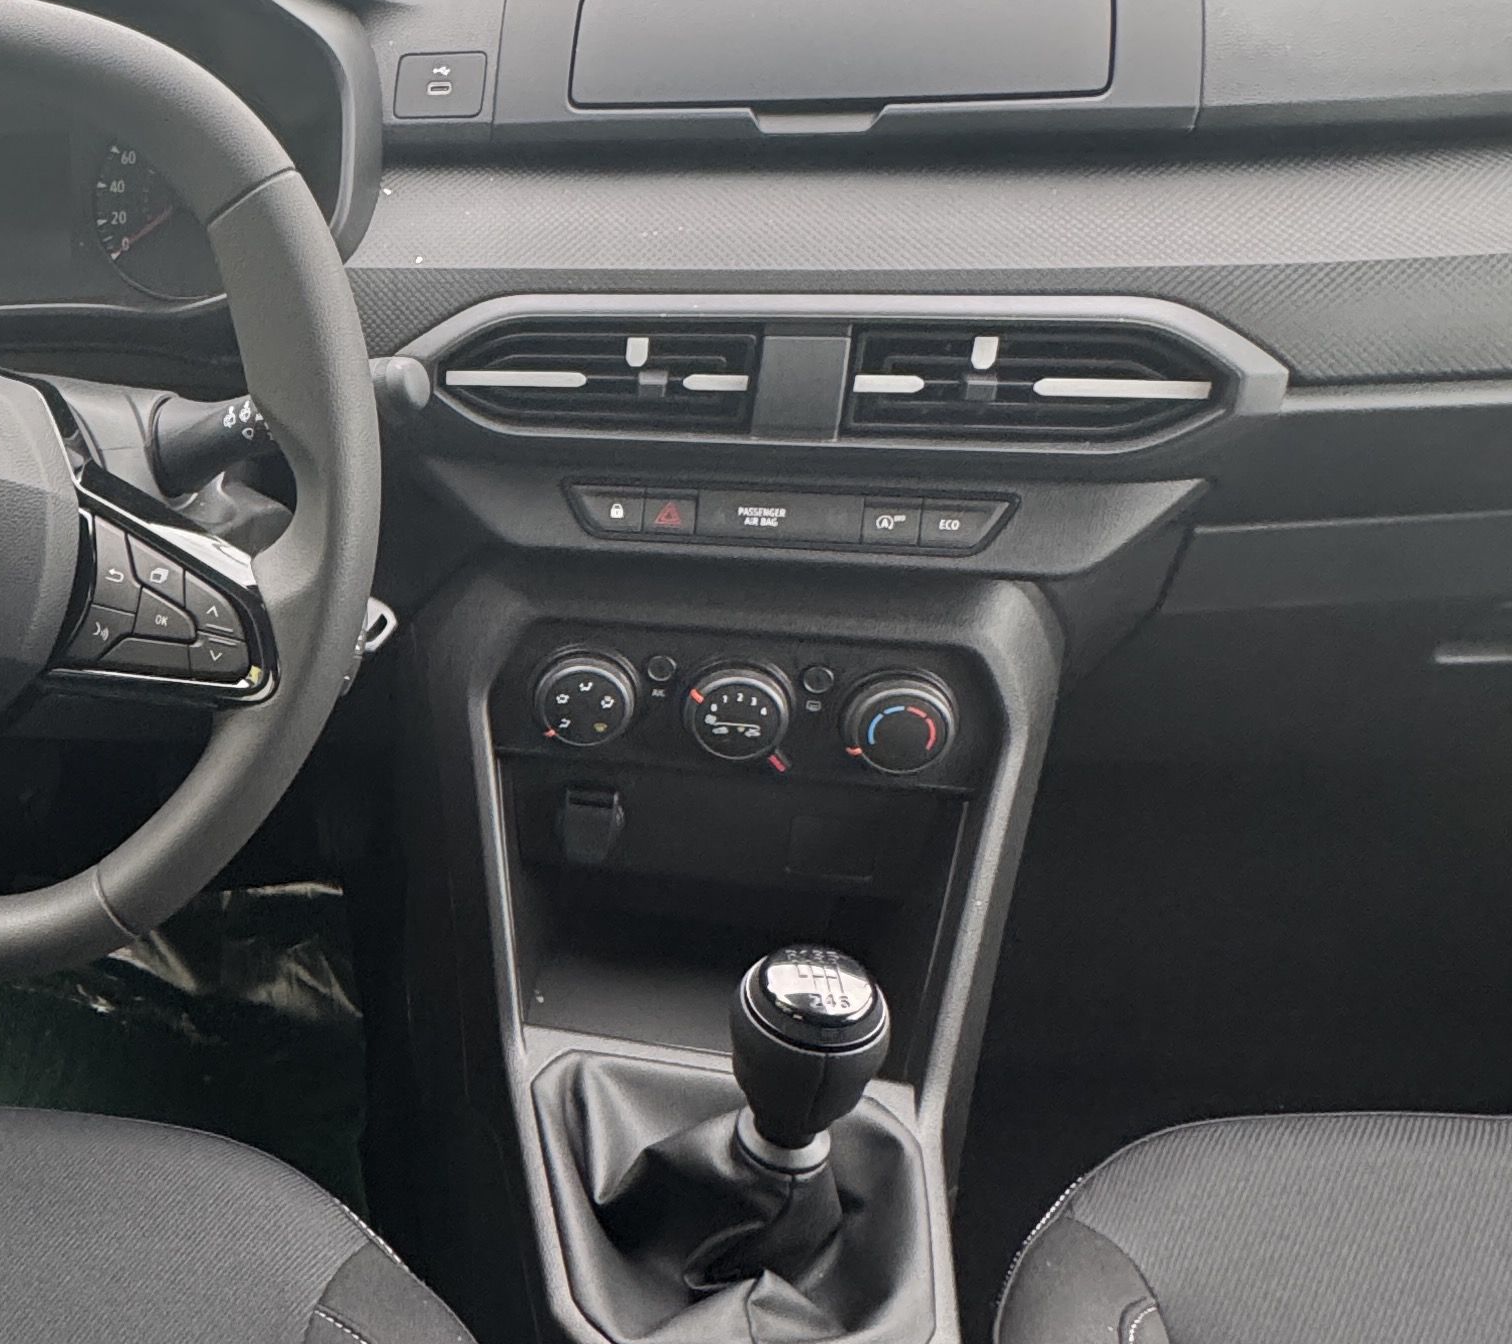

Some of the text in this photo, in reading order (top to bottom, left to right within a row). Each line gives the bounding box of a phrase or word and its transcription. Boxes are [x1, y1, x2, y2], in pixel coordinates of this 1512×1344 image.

[120, 150, 137, 165] 60
[109, 179, 125, 193] 40
[110, 211, 127, 225] 20
[737, 506, 787, 518] PASSENGER
[743, 516, 779, 528] AIR BAG
[938, 519, 960, 531] ECO
[155, 613, 169, 627] OK
[736, 692, 744, 703] 2
